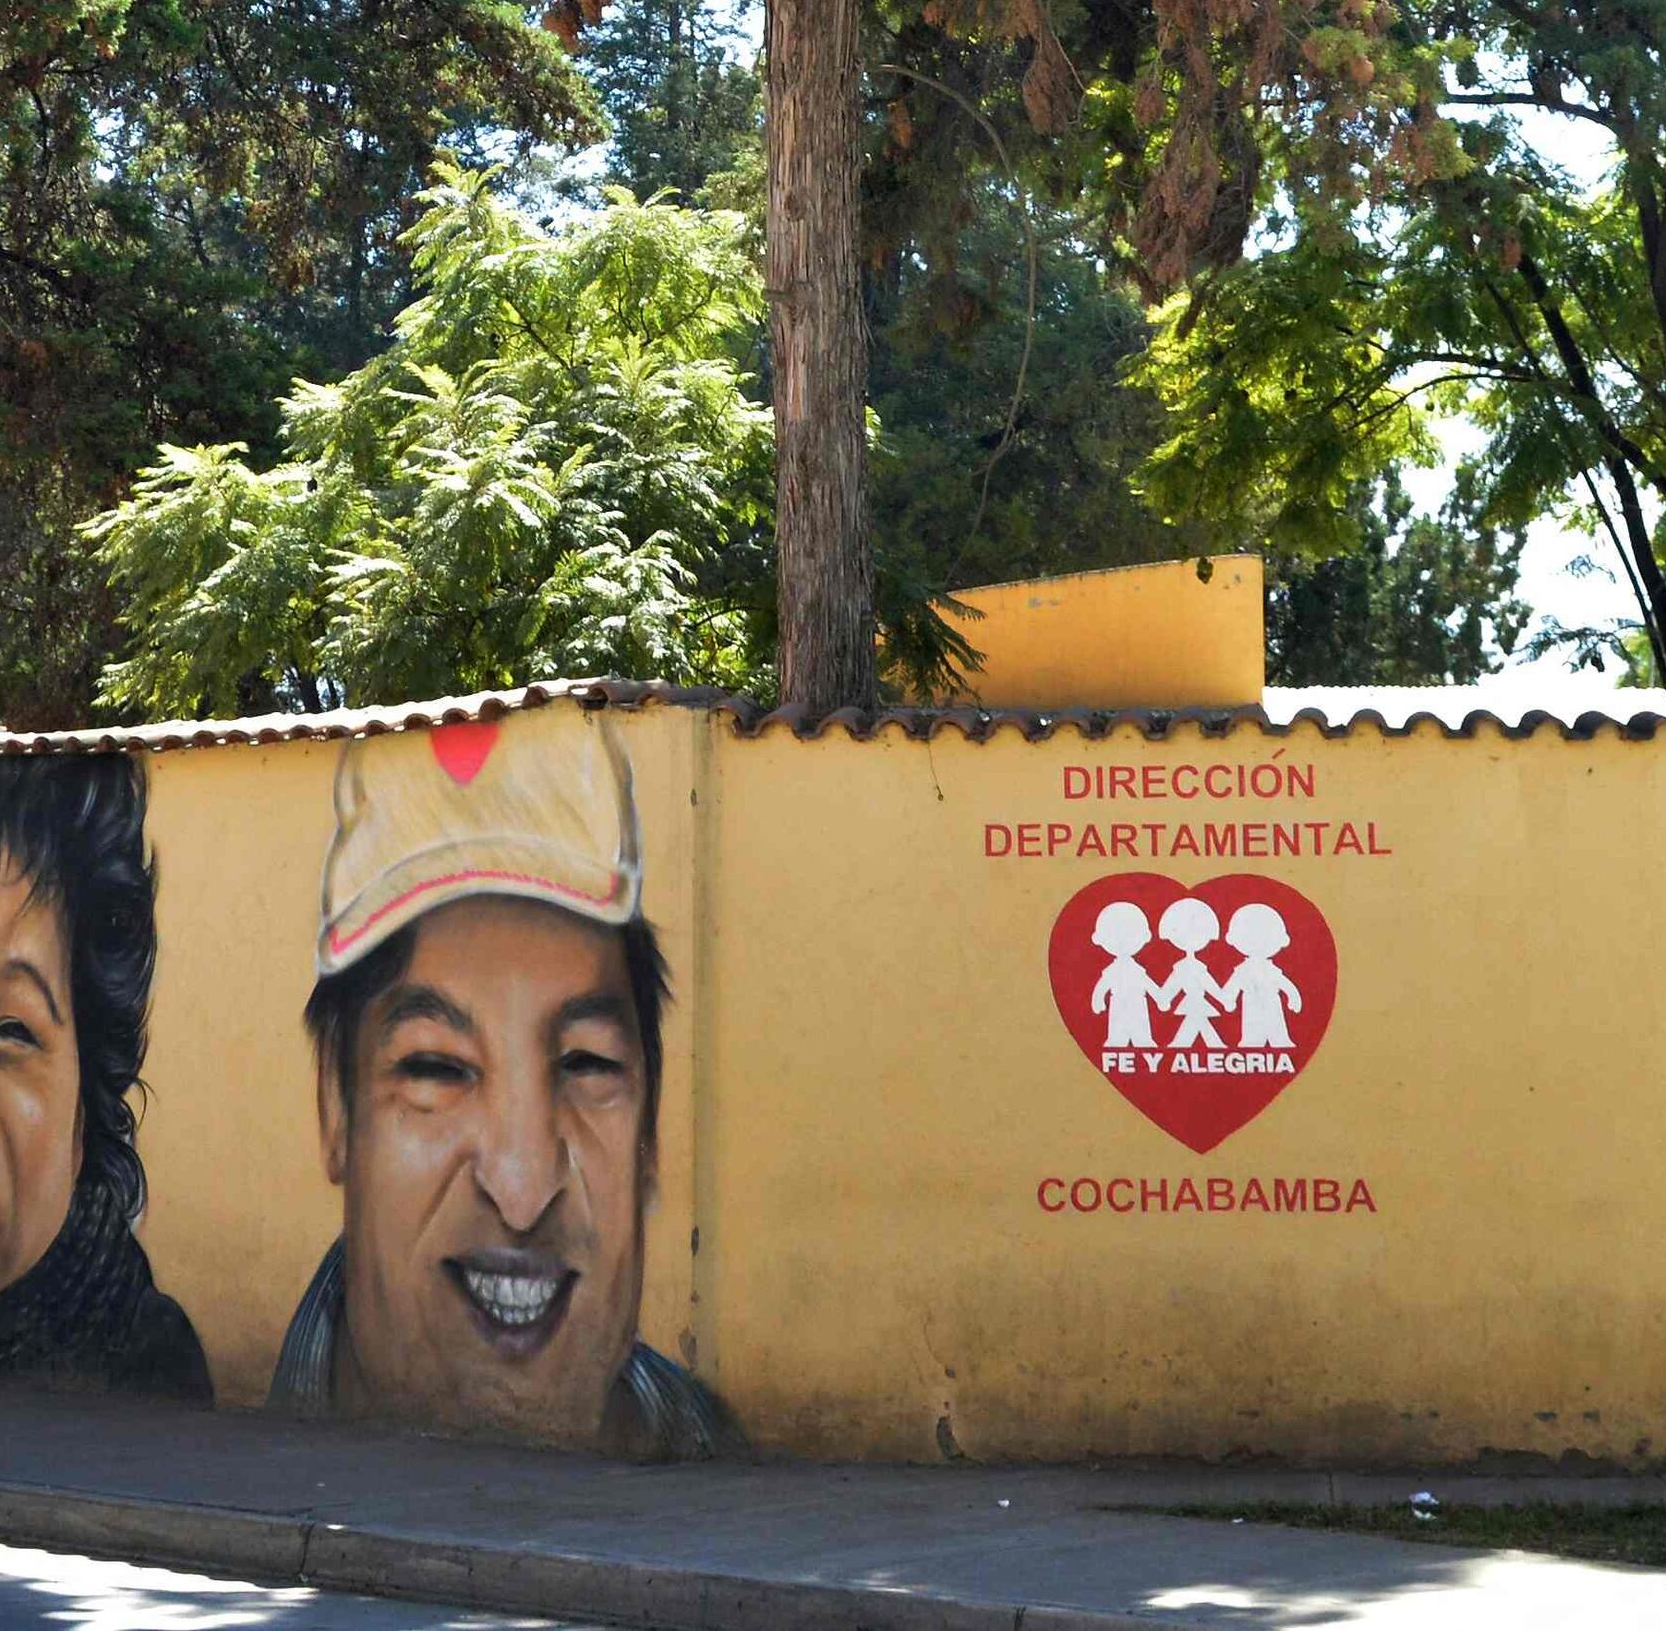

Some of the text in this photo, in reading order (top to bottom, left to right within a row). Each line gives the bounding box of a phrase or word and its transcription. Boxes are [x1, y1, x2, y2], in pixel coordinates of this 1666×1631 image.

[1063, 748, 1315, 800] DIRECCIÓN
[984, 822, 1393, 858] DEPARTAMENTAL
[1102, 1052, 1296, 1074] FE Y ALEGRIA
[1037, 1177, 1378, 1215] COCHABAMBA
